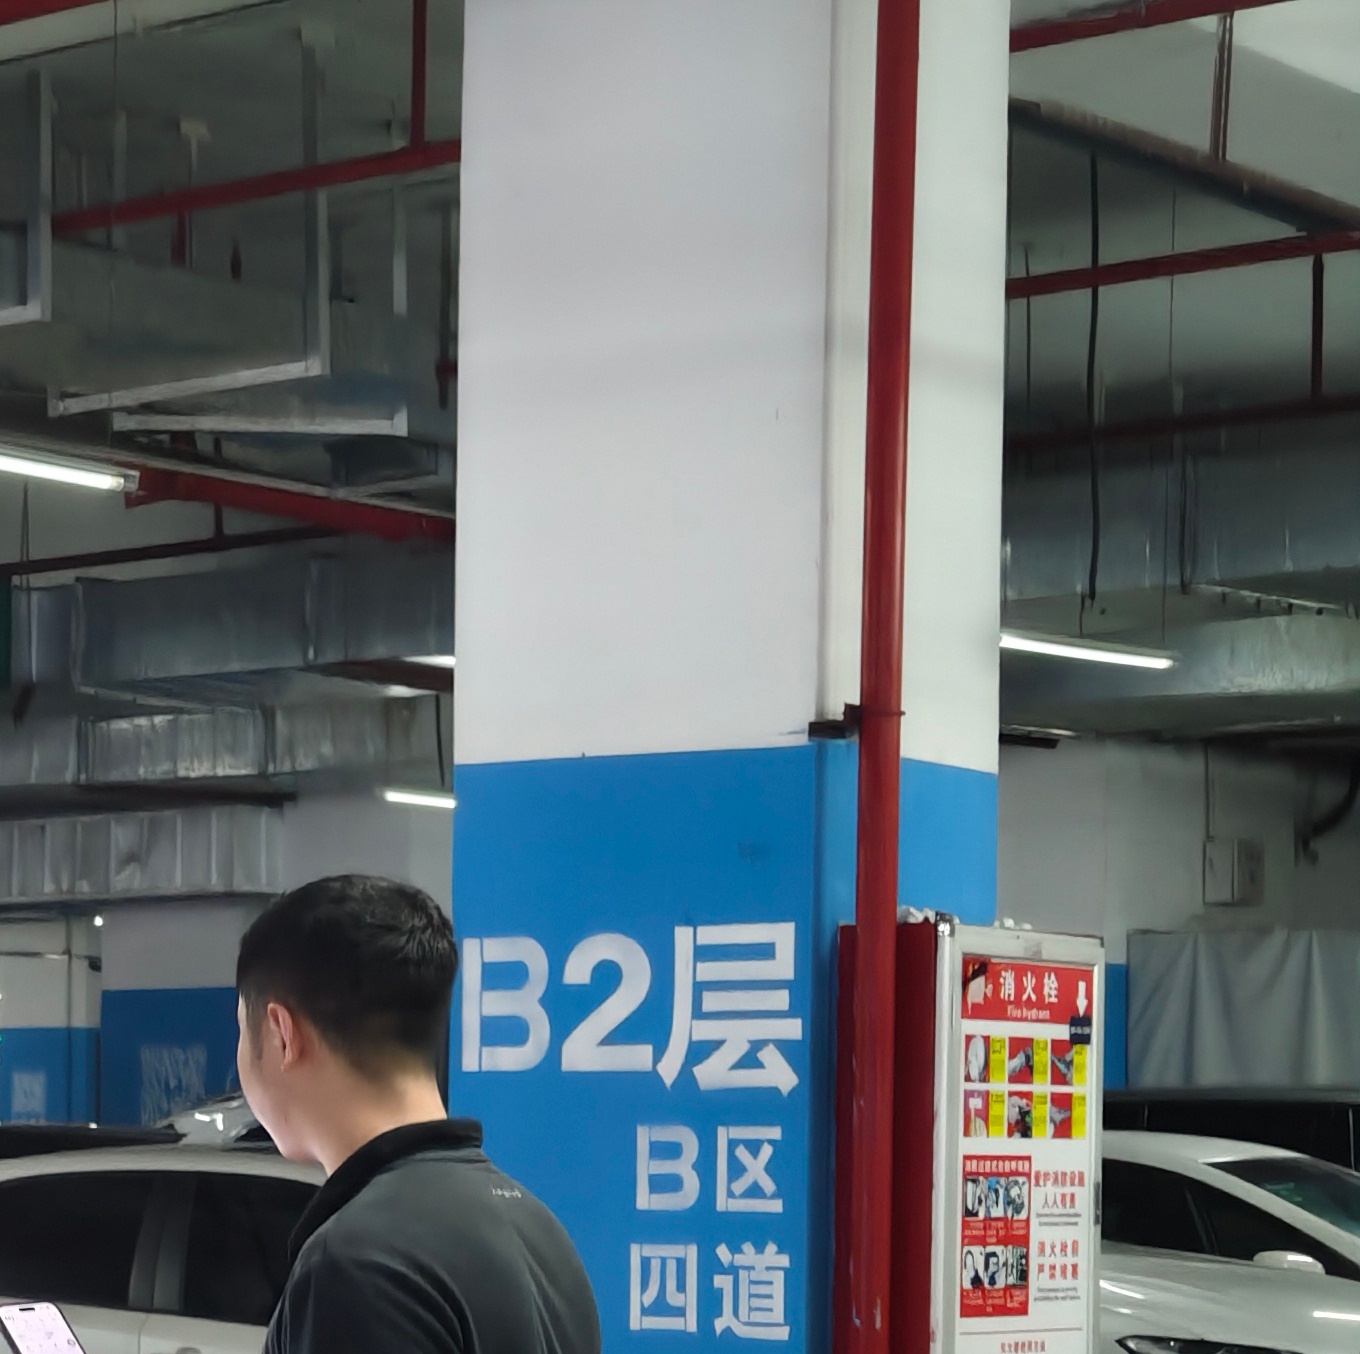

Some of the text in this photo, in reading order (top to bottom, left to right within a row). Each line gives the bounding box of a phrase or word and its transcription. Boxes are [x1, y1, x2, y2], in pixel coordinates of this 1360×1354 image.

[461, 921, 803, 1098] B2层
[999, 969, 1059, 1005] 消火栓
[629, 1240, 791, 1341] 四道
